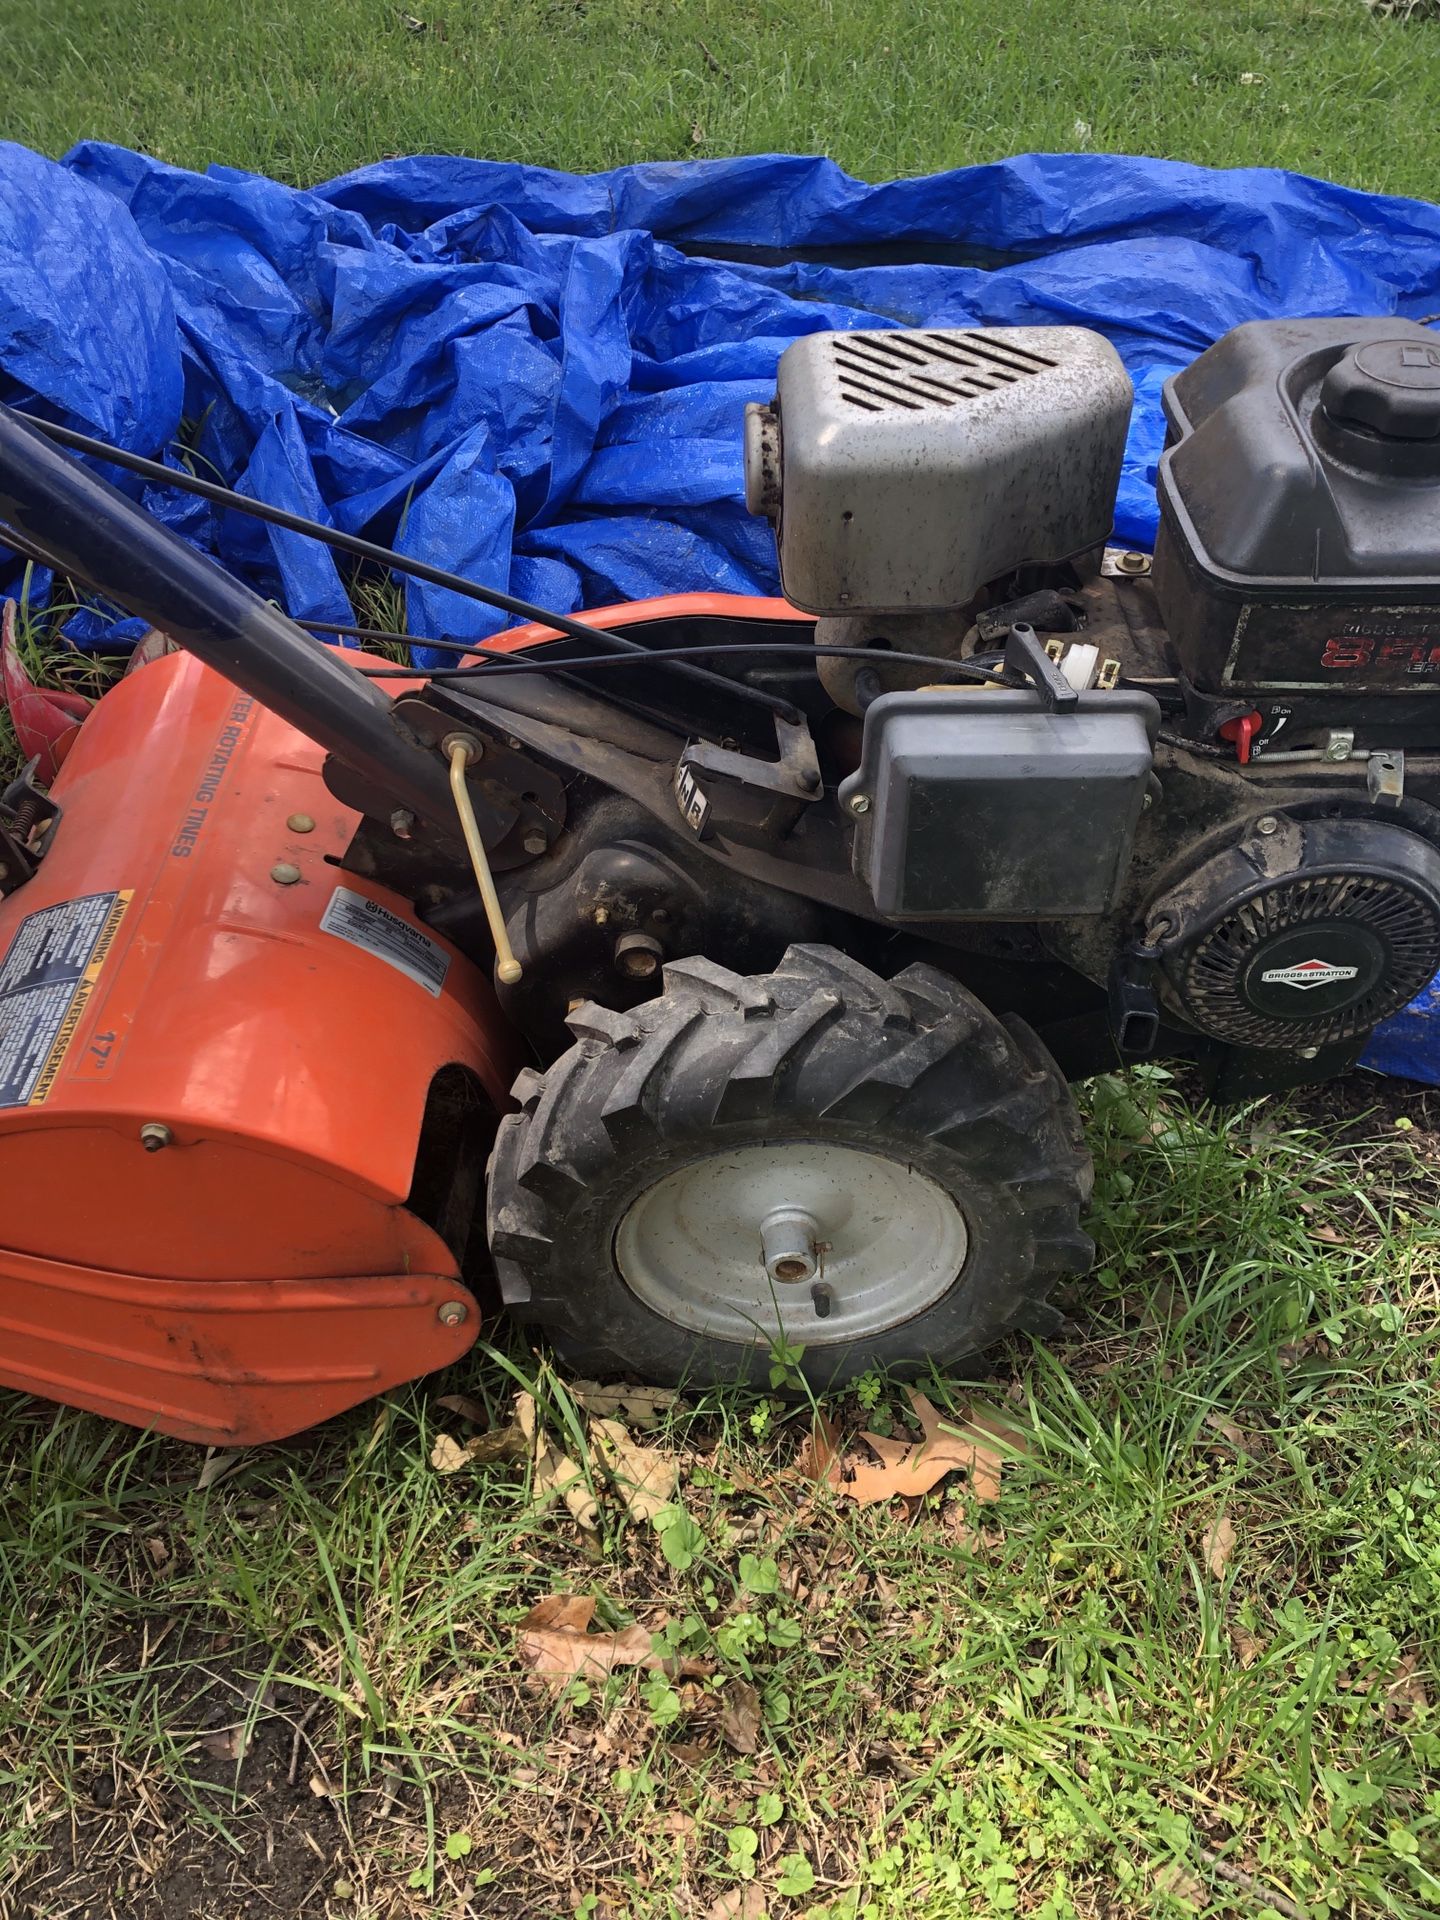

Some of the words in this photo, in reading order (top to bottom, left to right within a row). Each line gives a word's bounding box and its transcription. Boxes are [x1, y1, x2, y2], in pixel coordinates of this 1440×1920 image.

[230, 689, 254, 723] TER
[195, 726, 241, 804] ROTATING
[172, 808, 208, 858] TINES
[91, 907, 123, 965] WARNING
[378, 907, 431, 948] Husqvarna
[1308, 970, 1352, 978] STRATTON
[33, 990, 90, 1102] AVERTISSEMENT
